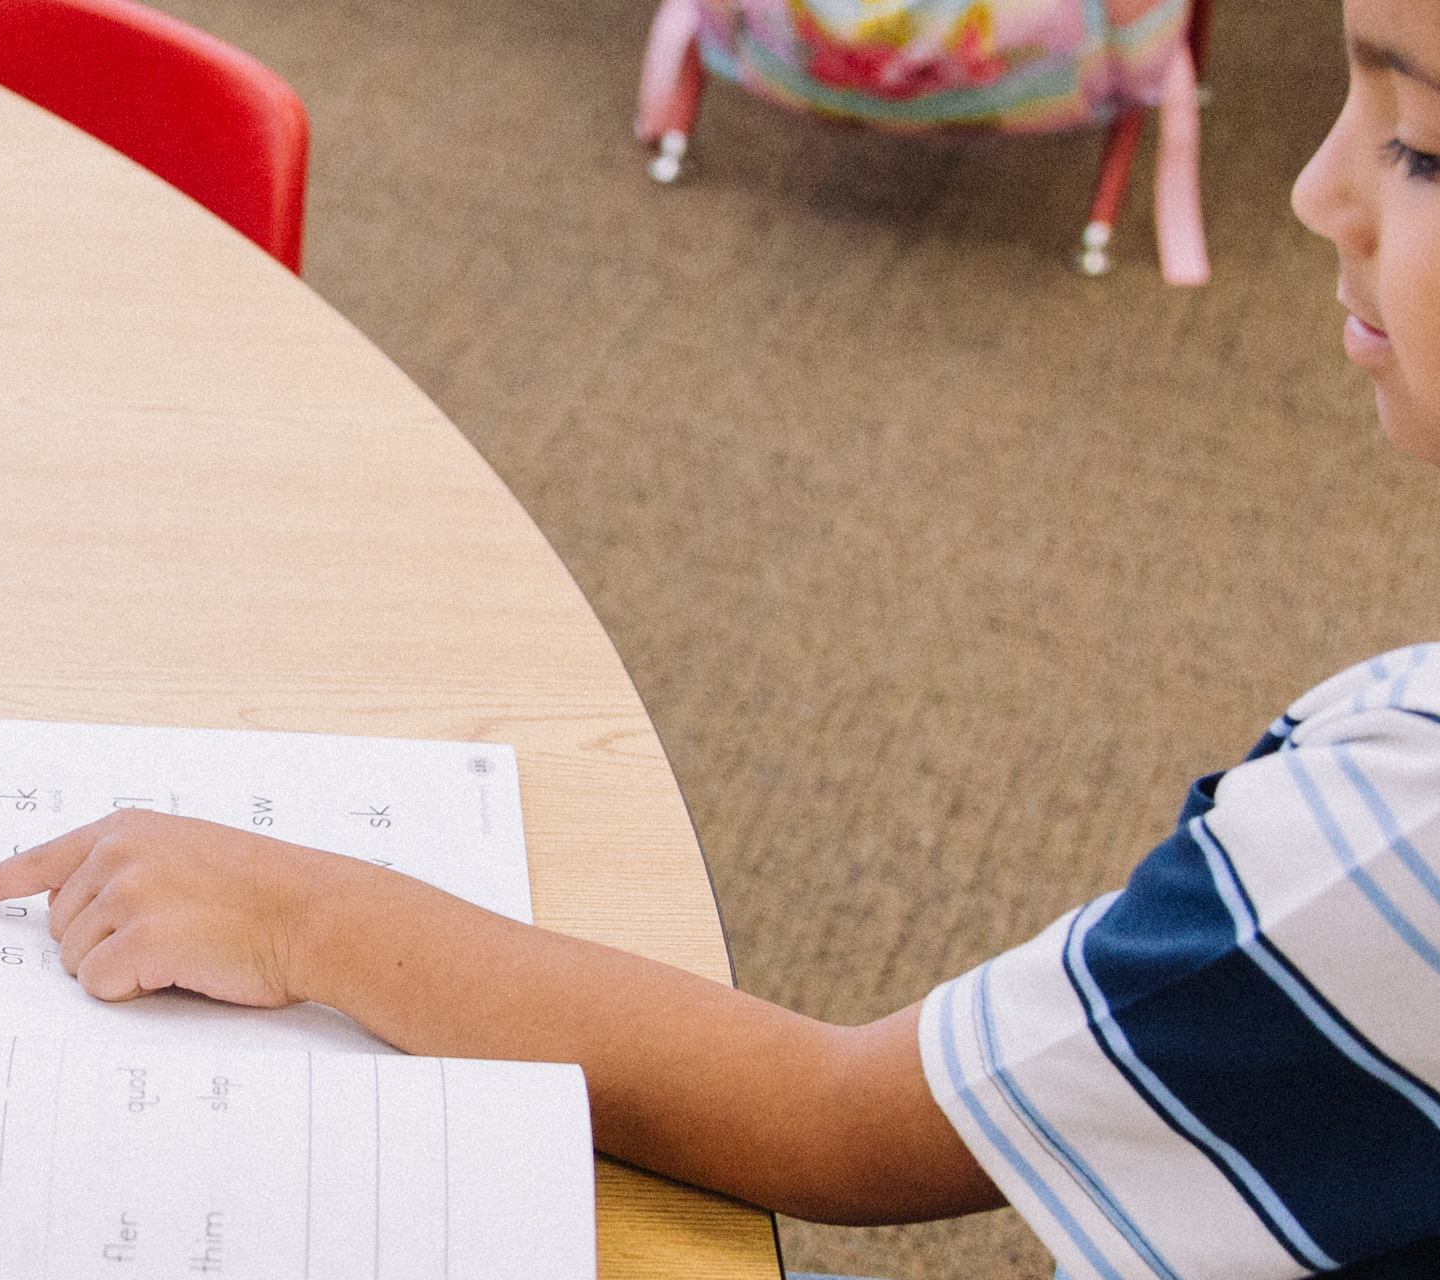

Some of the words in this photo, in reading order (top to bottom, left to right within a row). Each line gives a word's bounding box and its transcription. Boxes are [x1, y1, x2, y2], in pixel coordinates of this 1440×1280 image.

[252, 795, 273, 828] sw
[349, 805, 391, 829] sk
[118, 1067, 161, 1113] quad
[194, 1076, 243, 1111] slep
[102, 1212, 138, 1263] fler
[188, 1211, 224, 1272] thim
